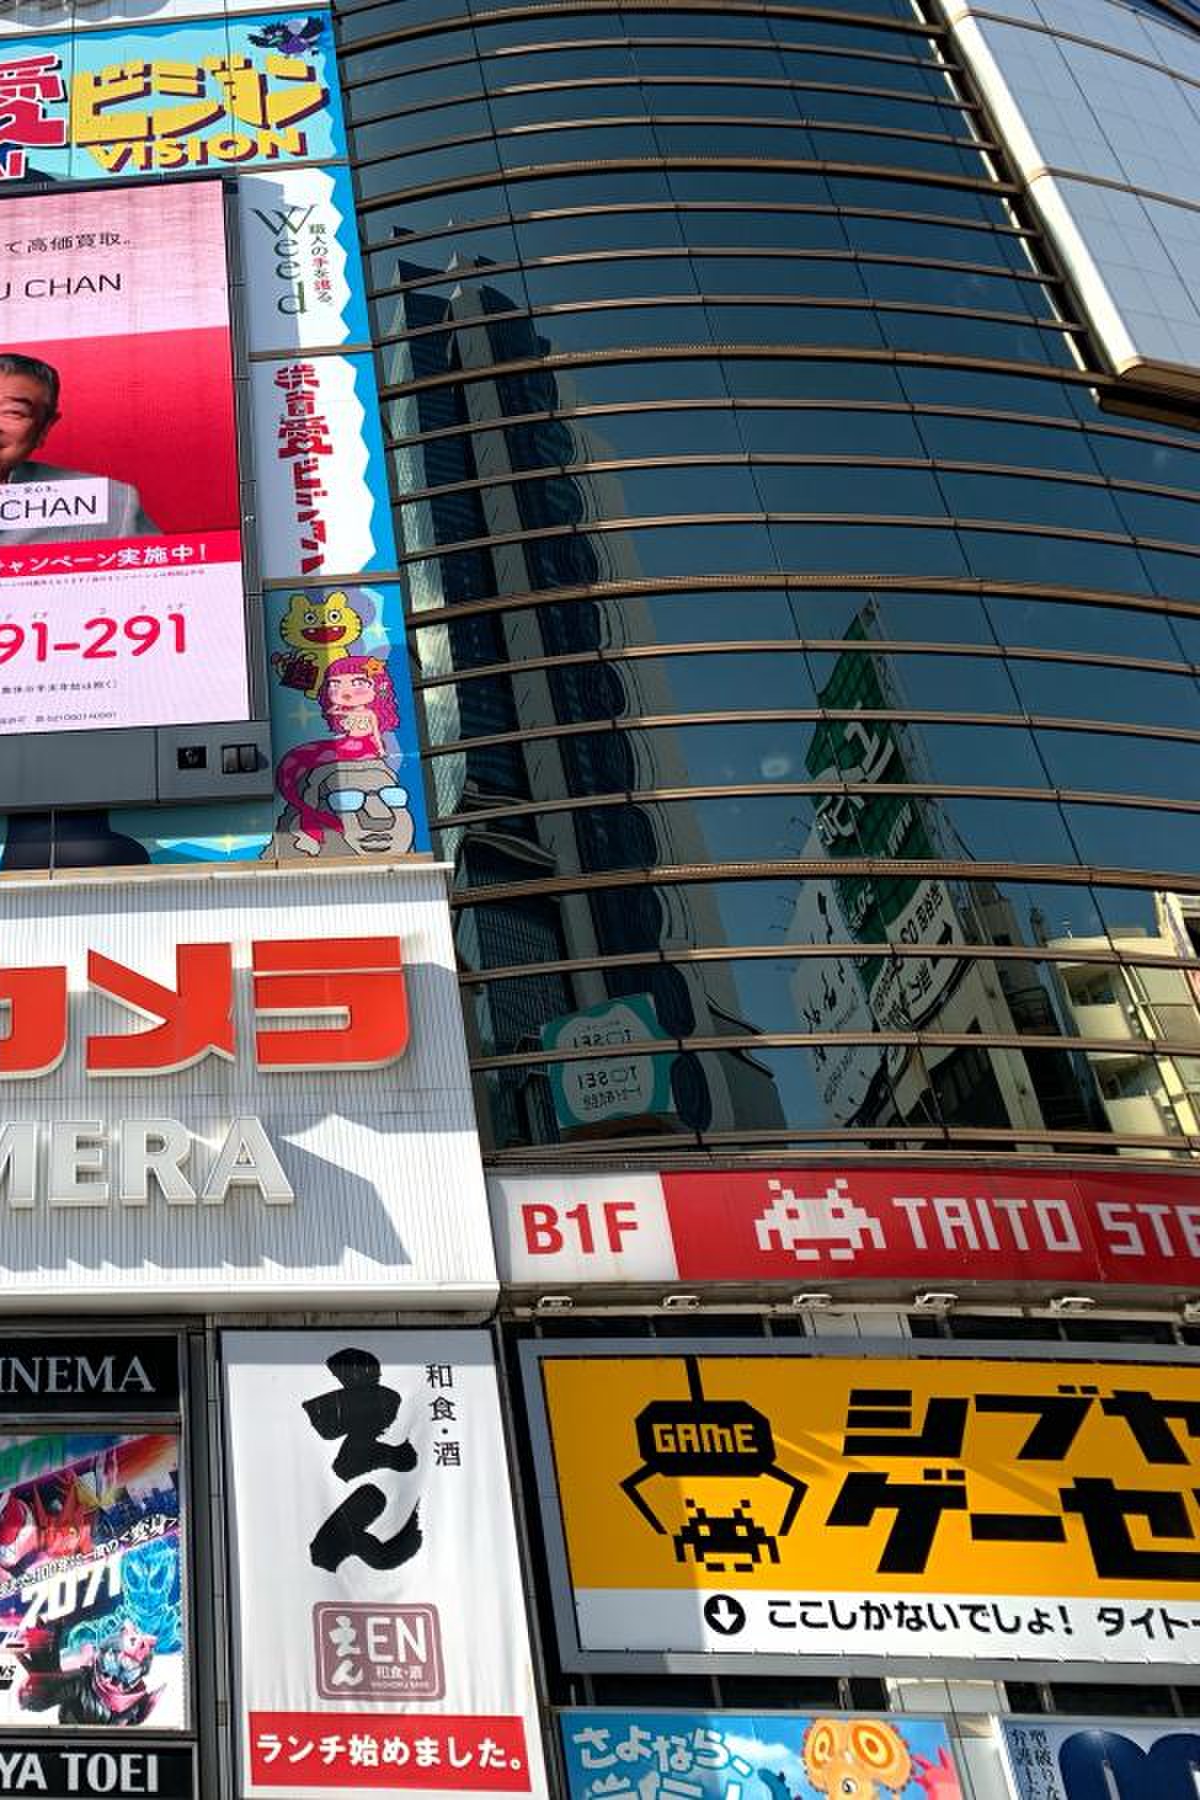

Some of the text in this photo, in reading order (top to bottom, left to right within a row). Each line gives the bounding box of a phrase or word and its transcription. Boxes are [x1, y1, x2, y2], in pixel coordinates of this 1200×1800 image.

[87, 128, 307, 172] VISION
[25, 272, 123, 299] CHAN
[0, 494, 98, 522] CHAN
[520, 1202, 638, 1255] B1F
[892, 1197, 1082, 1253] TAITO
[426, 1363, 462, 1467] 和食・酒
[843, 1385, 1200, 1466] シブヤ
[302, 1347, 423, 1573] えん
[826, 1469, 1200, 1581] ゲーセ
[367, 1616, 427, 1664] EN
[1097, 1606, 1200, 1640] タイト
[60, 1753, 159, 1793] TOEI
[256, 1733, 522, 1770] ランチ始めました。
